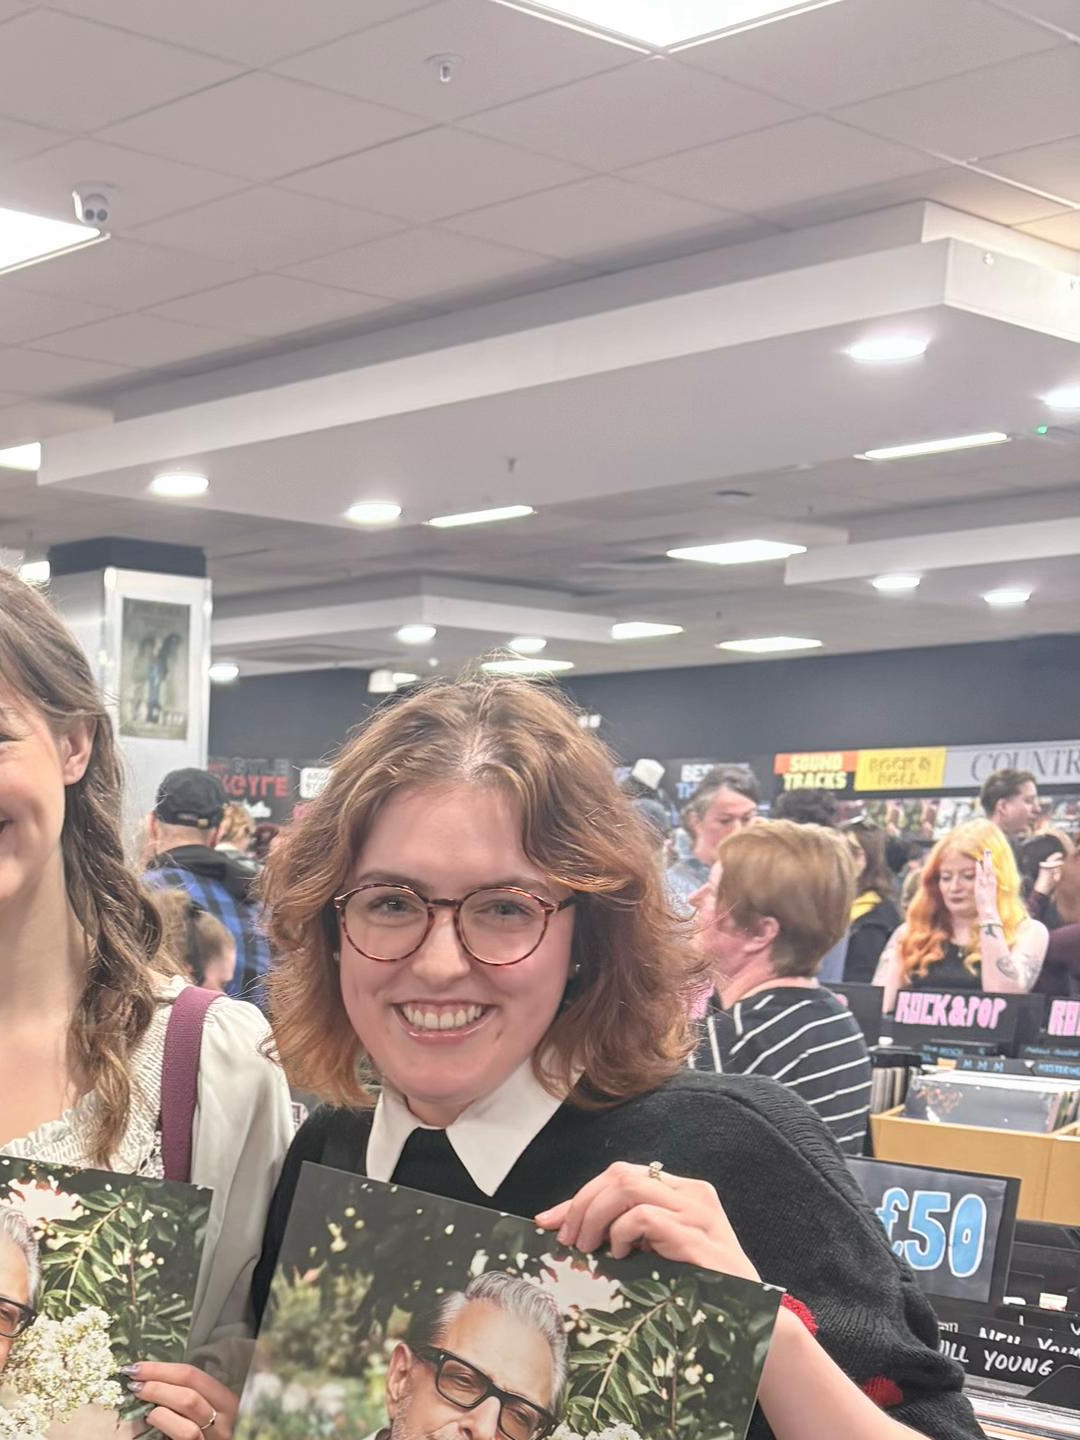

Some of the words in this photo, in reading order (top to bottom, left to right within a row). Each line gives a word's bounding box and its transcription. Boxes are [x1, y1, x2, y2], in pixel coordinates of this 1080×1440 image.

[789, 753, 843, 772] SOUND
[783, 771, 847, 791] TRACKS
[875, 1187, 987, 1278] £50
[983, 1349, 1054, 1376] YOUNG
